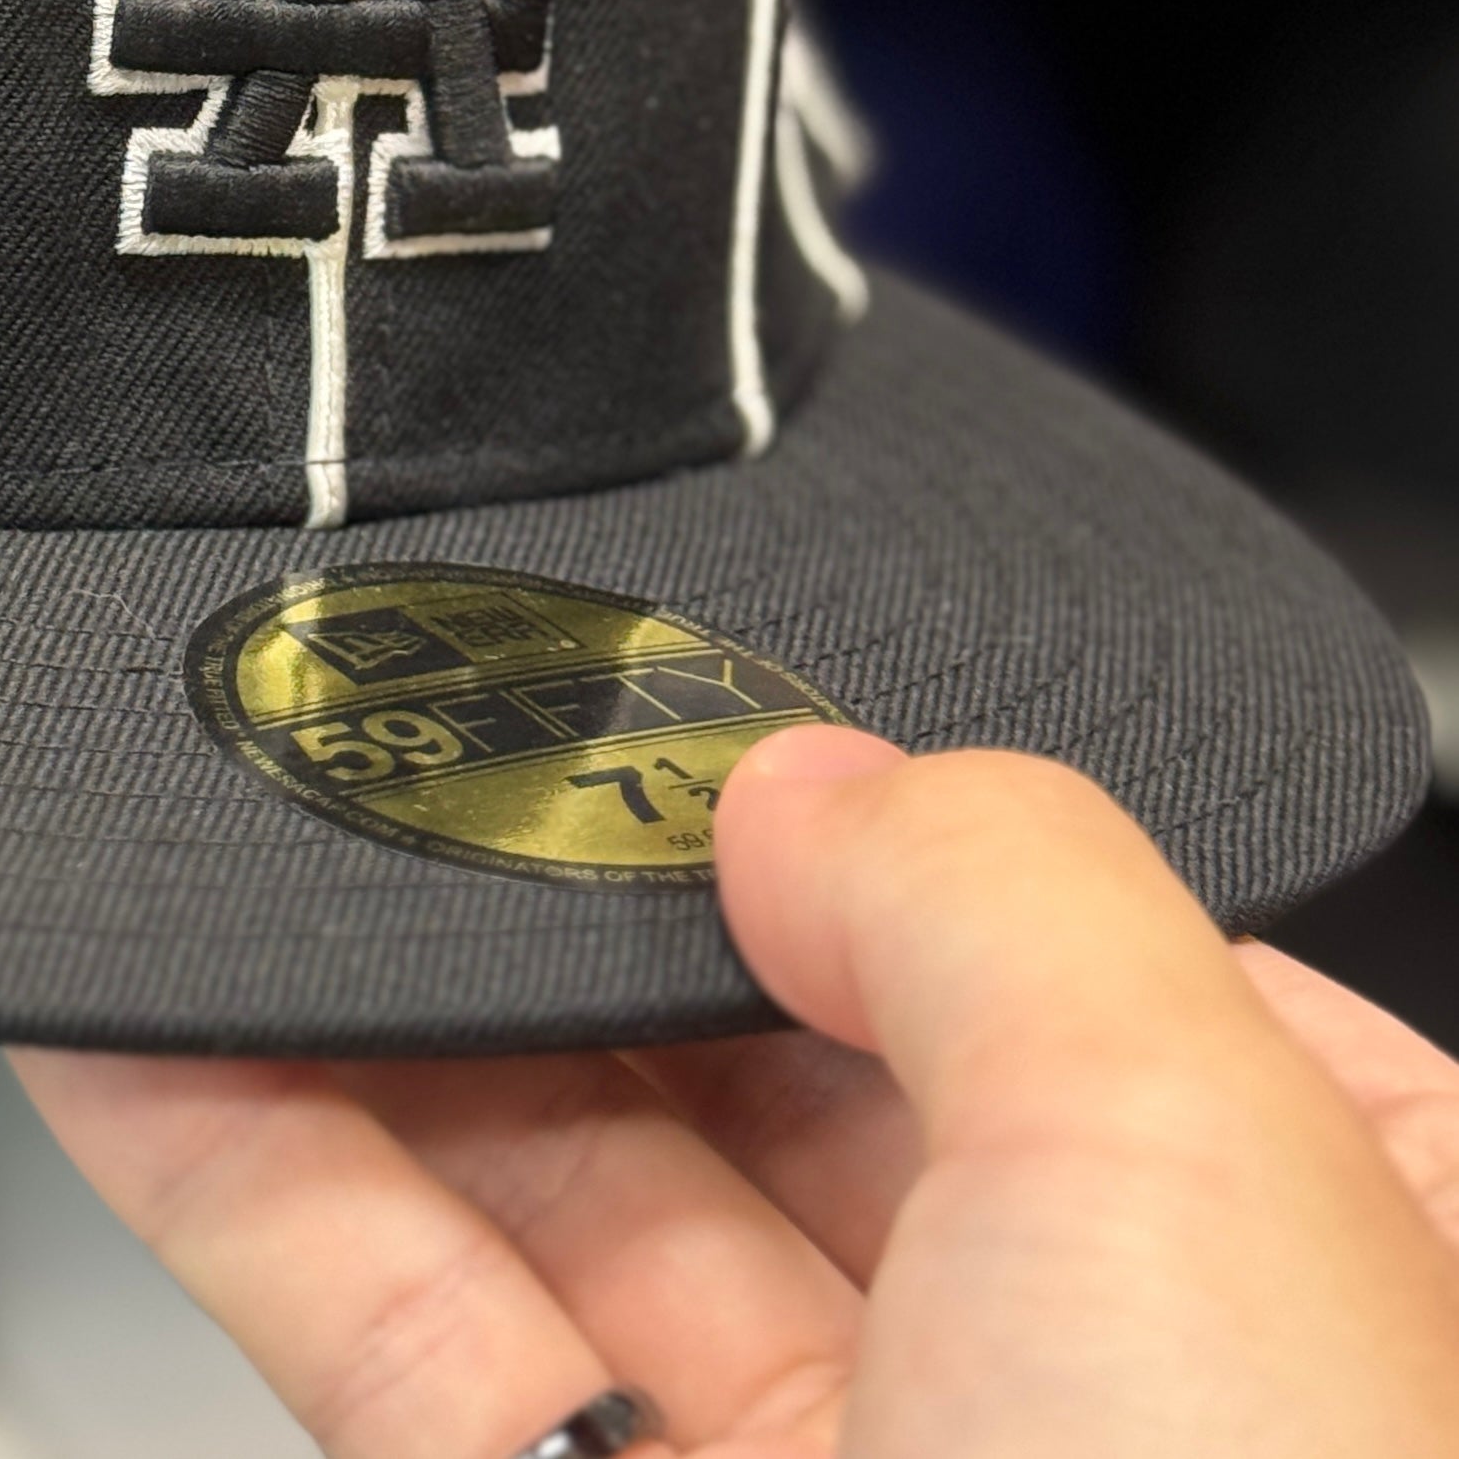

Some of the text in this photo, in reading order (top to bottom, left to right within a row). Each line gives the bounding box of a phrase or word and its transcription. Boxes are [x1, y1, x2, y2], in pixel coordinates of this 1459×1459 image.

[290, 659, 762, 781] 59FIFTY
[564, 765, 666, 824] 7
[604, 870, 638, 883] OF
[641, 870, 691, 883] THE
